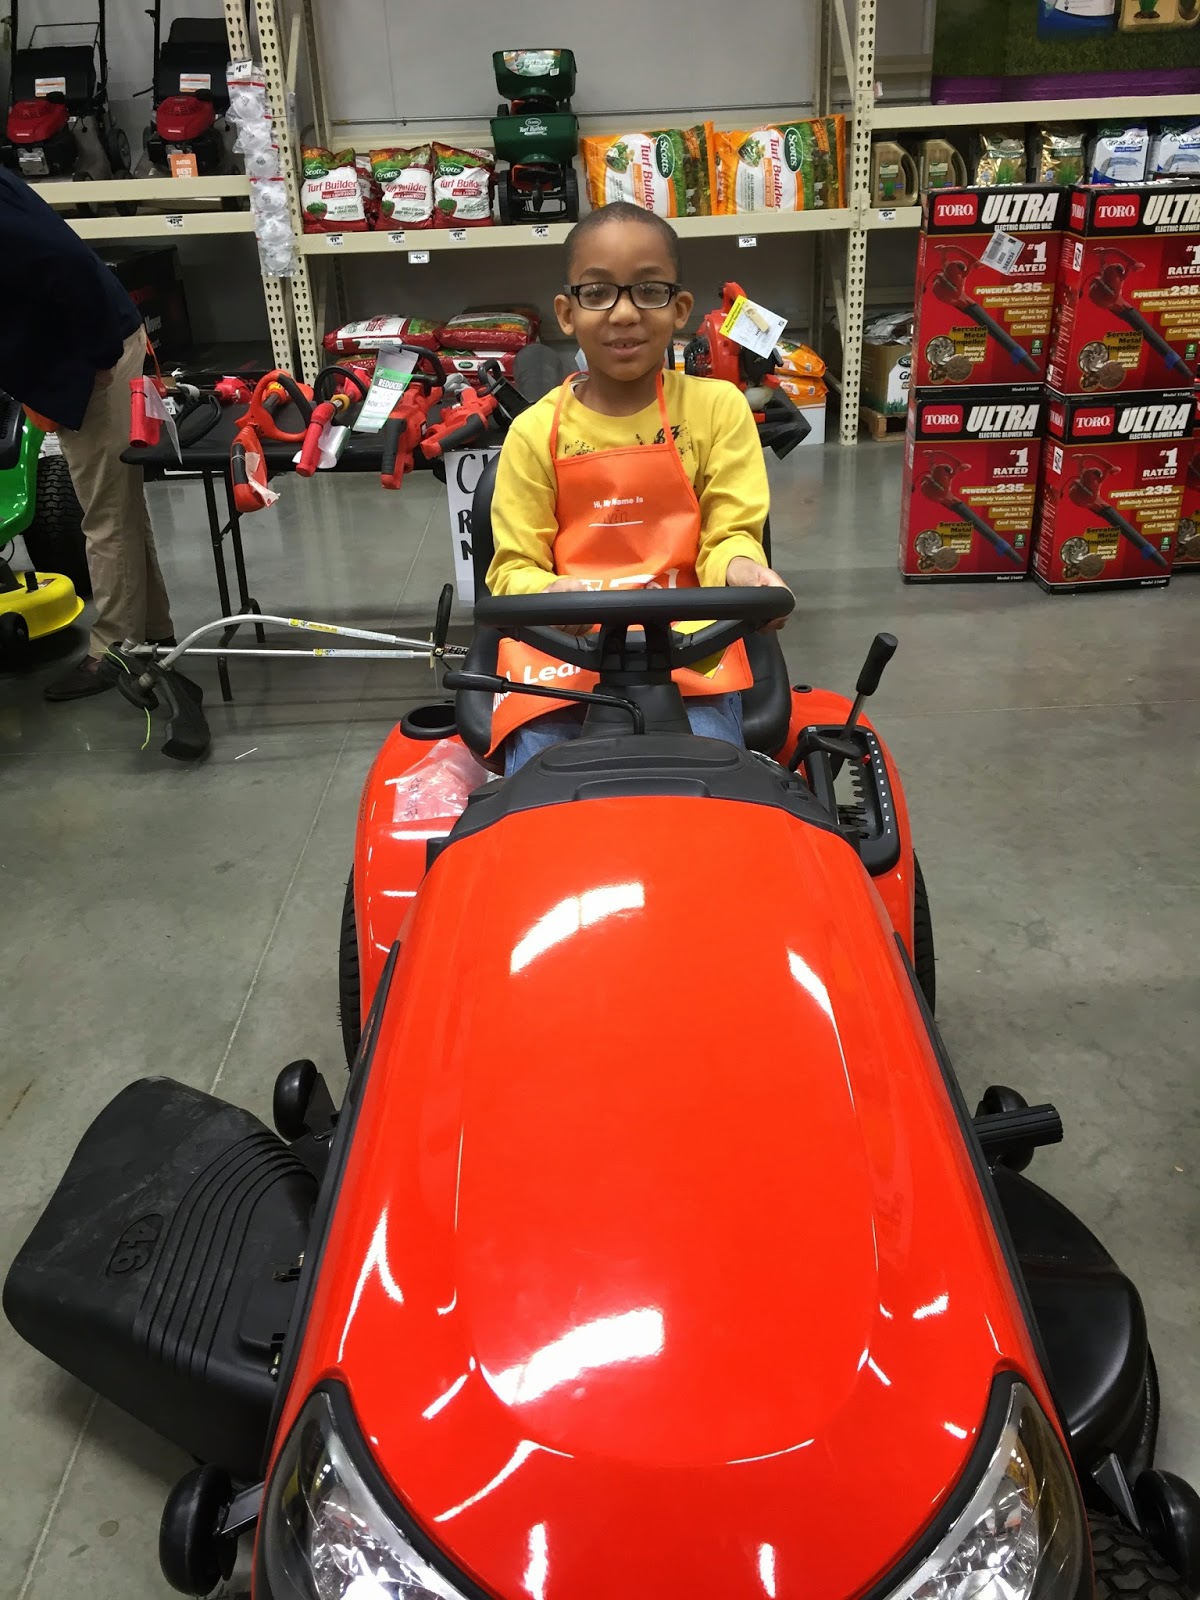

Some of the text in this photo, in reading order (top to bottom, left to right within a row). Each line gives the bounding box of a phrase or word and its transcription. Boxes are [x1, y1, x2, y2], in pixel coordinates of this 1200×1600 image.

[788, 134, 798, 167] Scotts
[660, 140, 670, 175] Scotts
[641, 143, 655, 210] Turf Builde
[770, 138, 783, 209] Turf Builder
[308, 180, 358, 193] Turf Builder
[440, 180, 479, 188] Turf Build
[938, 192, 1060, 225] TORO ULTRA
[1099, 194, 1200, 226] TORO ULTR
[994, 222, 1053, 232] ELECTRIC BLOWER VAC
[1155, 224, 1200, 233] ELECTRIC BLOWER
[1027, 241, 1047, 263] #1
[1010, 264, 1047, 273] RATED
[1013, 282, 1043, 293] 235
[1134, 285, 1200, 299] POWERFUL 235
[378, 378, 404, 390] REDUCED
[925, 404, 1041, 433] TORO ULTRA
[1076, 404, 1192, 434] TORO ULTRA
[1010, 448, 1029, 467] #1
[1160, 448, 1179, 468] #1
[993, 467, 1029, 475] RATED
[1143, 468, 1178, 477] RATED
[996, 484, 1025, 493] 235
[1145, 485, 1173, 496] 235
[603, 500, 612, 508] My
[611, 498, 634, 506] Name
[449, 646, 469, 655] ECH
[524, 662, 581, 685] Lea
